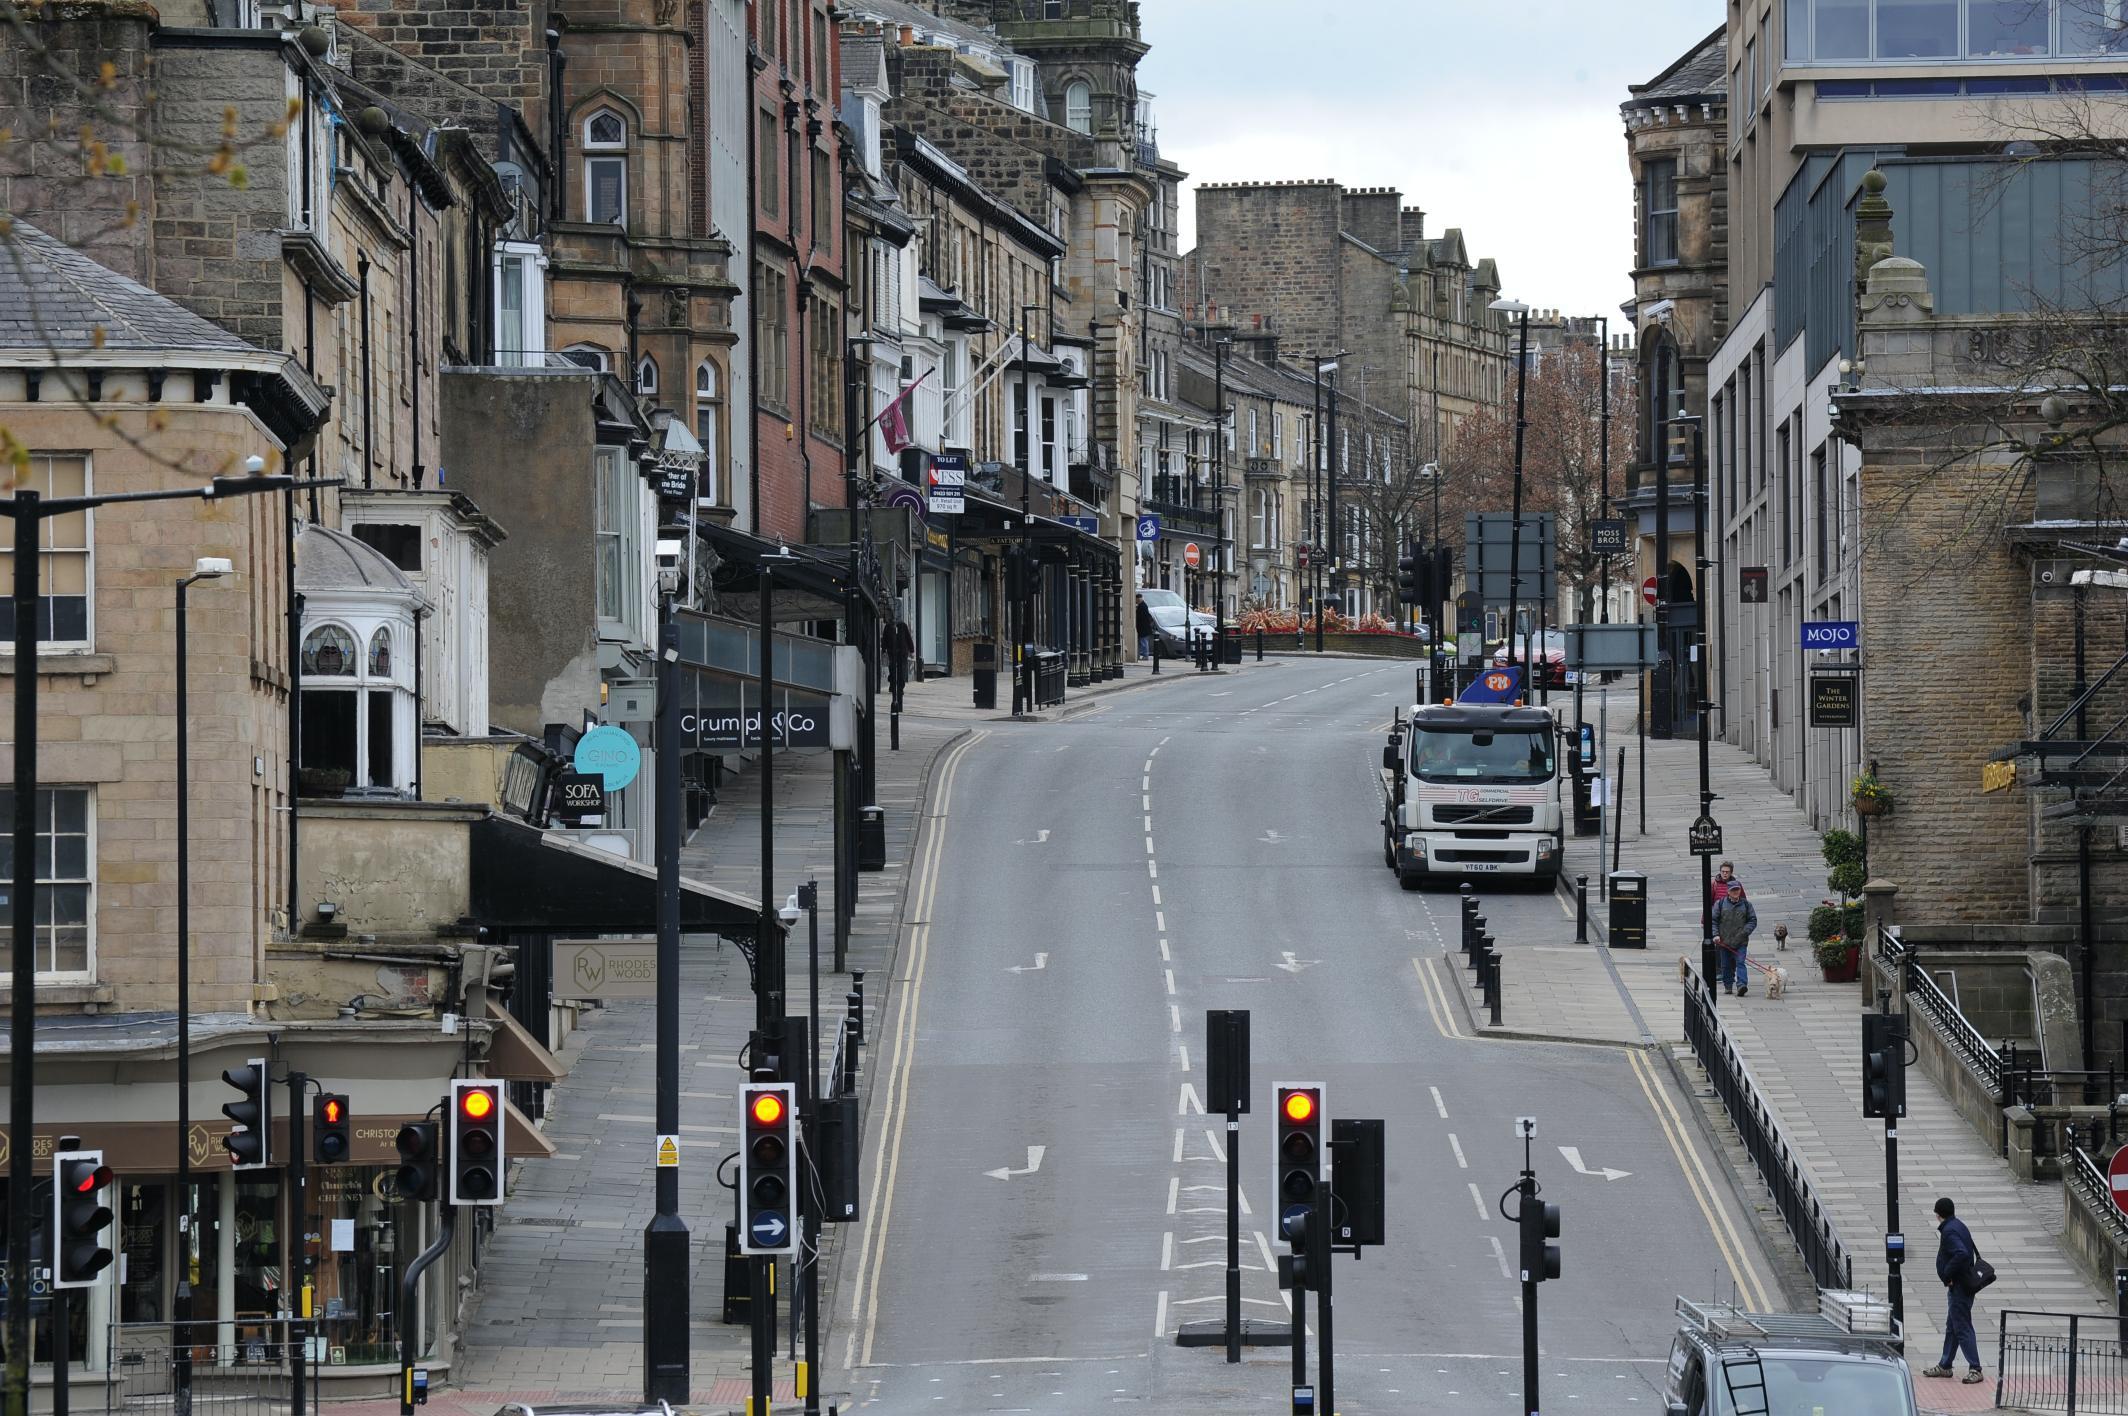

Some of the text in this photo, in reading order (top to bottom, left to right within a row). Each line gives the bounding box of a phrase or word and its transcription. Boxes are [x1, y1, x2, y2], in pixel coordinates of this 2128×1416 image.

[671, 481, 686, 489] Bride
[1807, 628, 1850, 643] MOJO
[1488, 676, 1508, 689] PM
[788, 714, 815, 731] Co
[588, 750, 627, 763] GINO
[565, 784, 600, 798] SOFA
[608, 959, 656, 969] RHODES
[615, 969, 651, 978] WOOD
